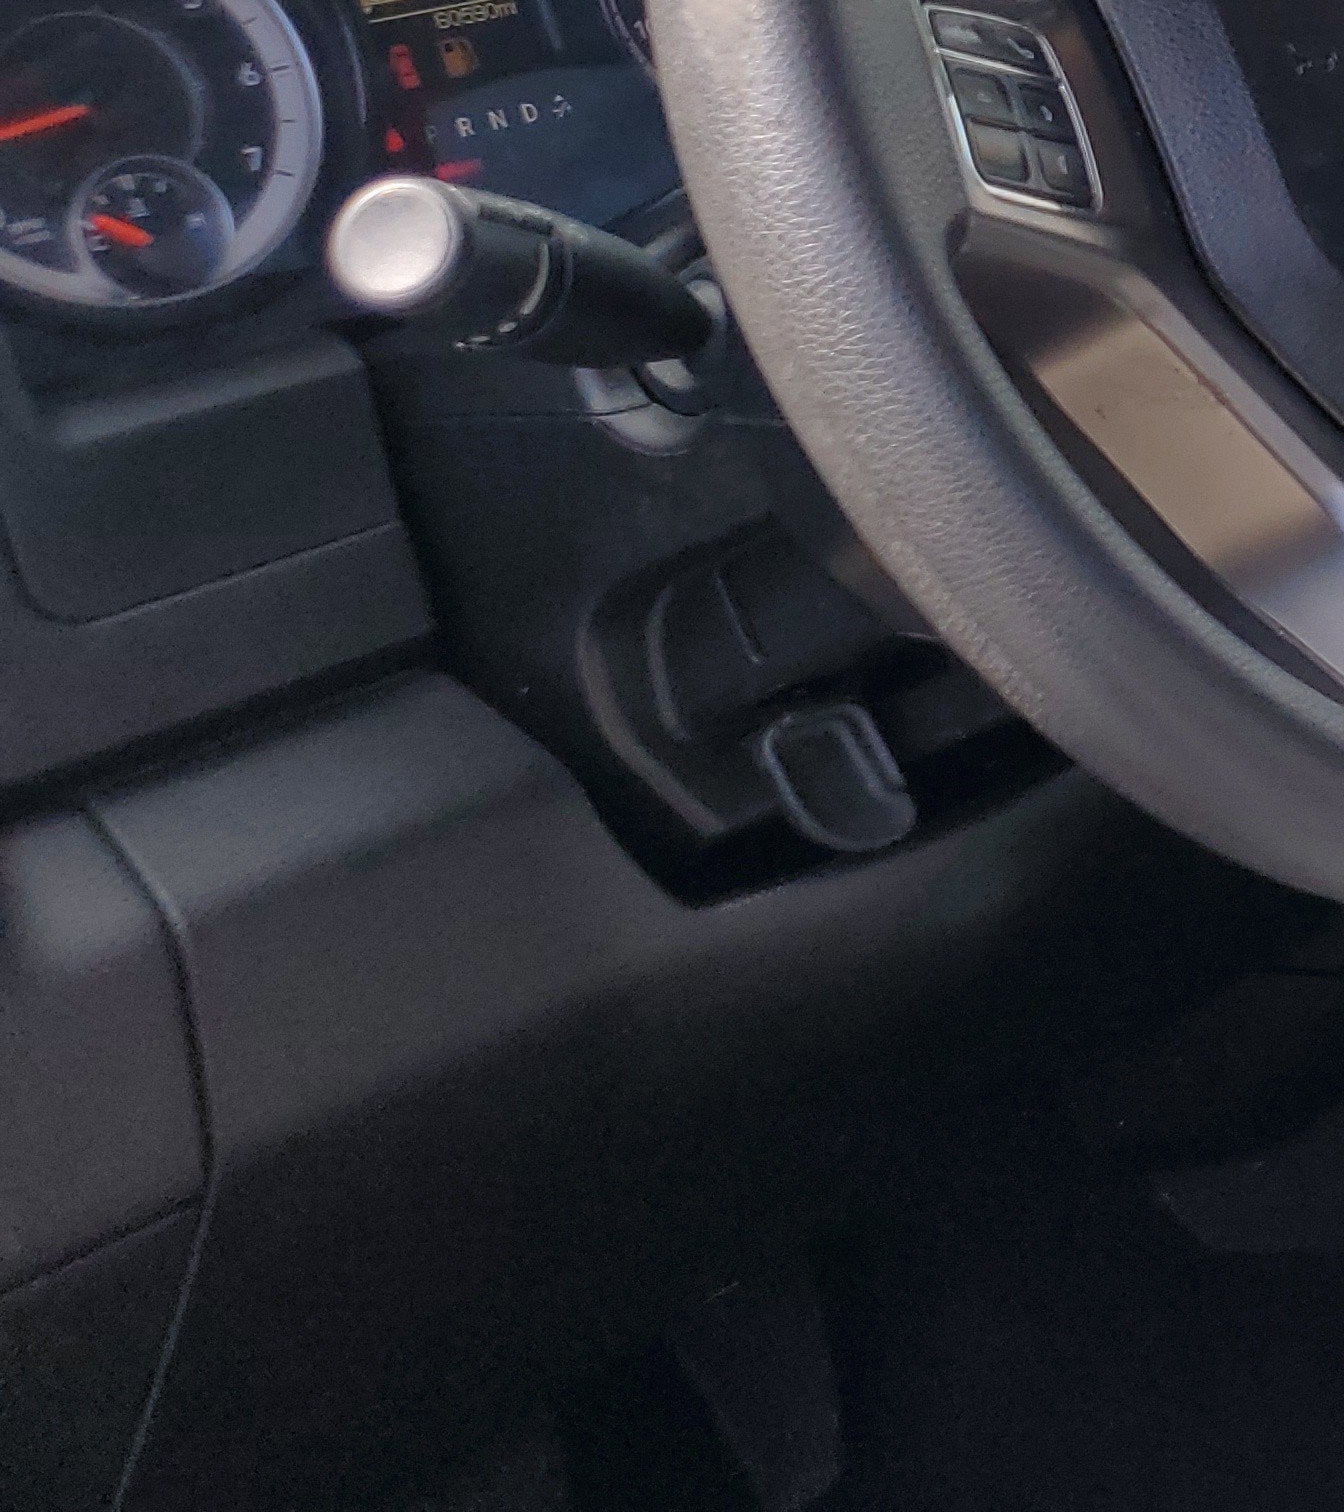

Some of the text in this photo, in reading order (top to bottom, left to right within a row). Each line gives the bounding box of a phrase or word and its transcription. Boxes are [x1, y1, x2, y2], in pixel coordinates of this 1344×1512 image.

[454, 116, 477, 138] R
[486, 109, 509, 131] N
[518, 102, 539, 124] D
